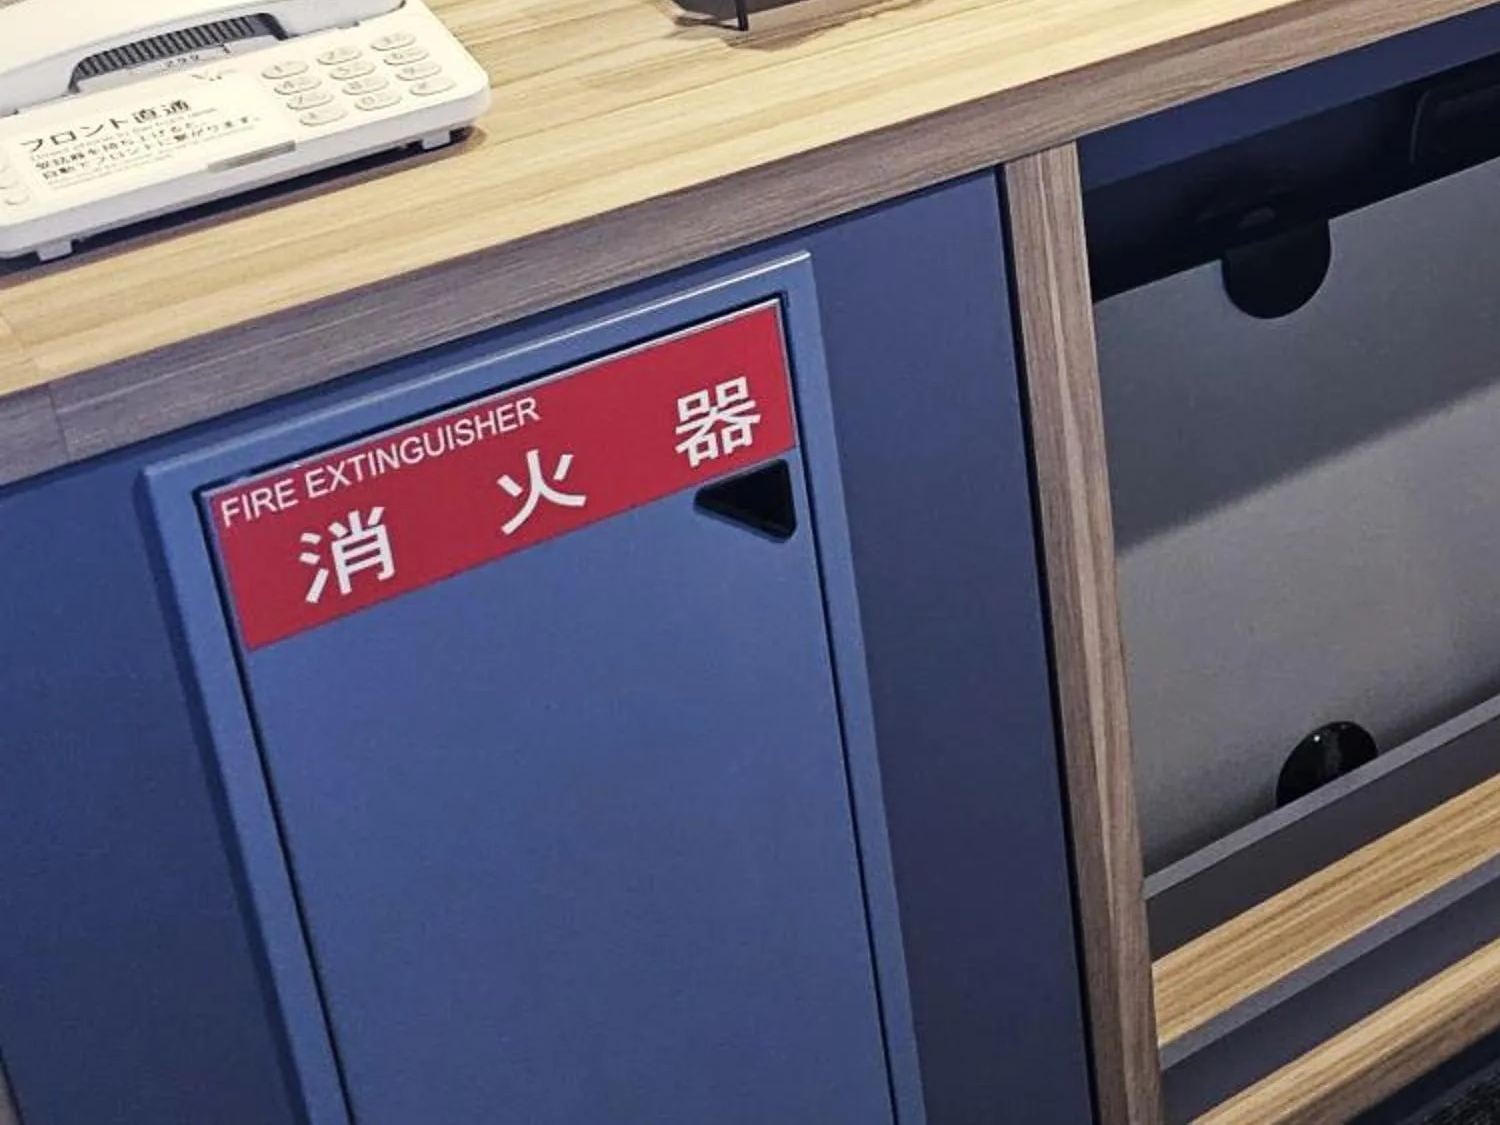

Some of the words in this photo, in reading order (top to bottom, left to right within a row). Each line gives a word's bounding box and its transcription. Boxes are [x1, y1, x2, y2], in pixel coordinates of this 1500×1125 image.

[19, 98, 191, 153] フロント直通
[221, 479, 298, 528] FIRE
[305, 397, 541, 499] EXTINGUISHER
